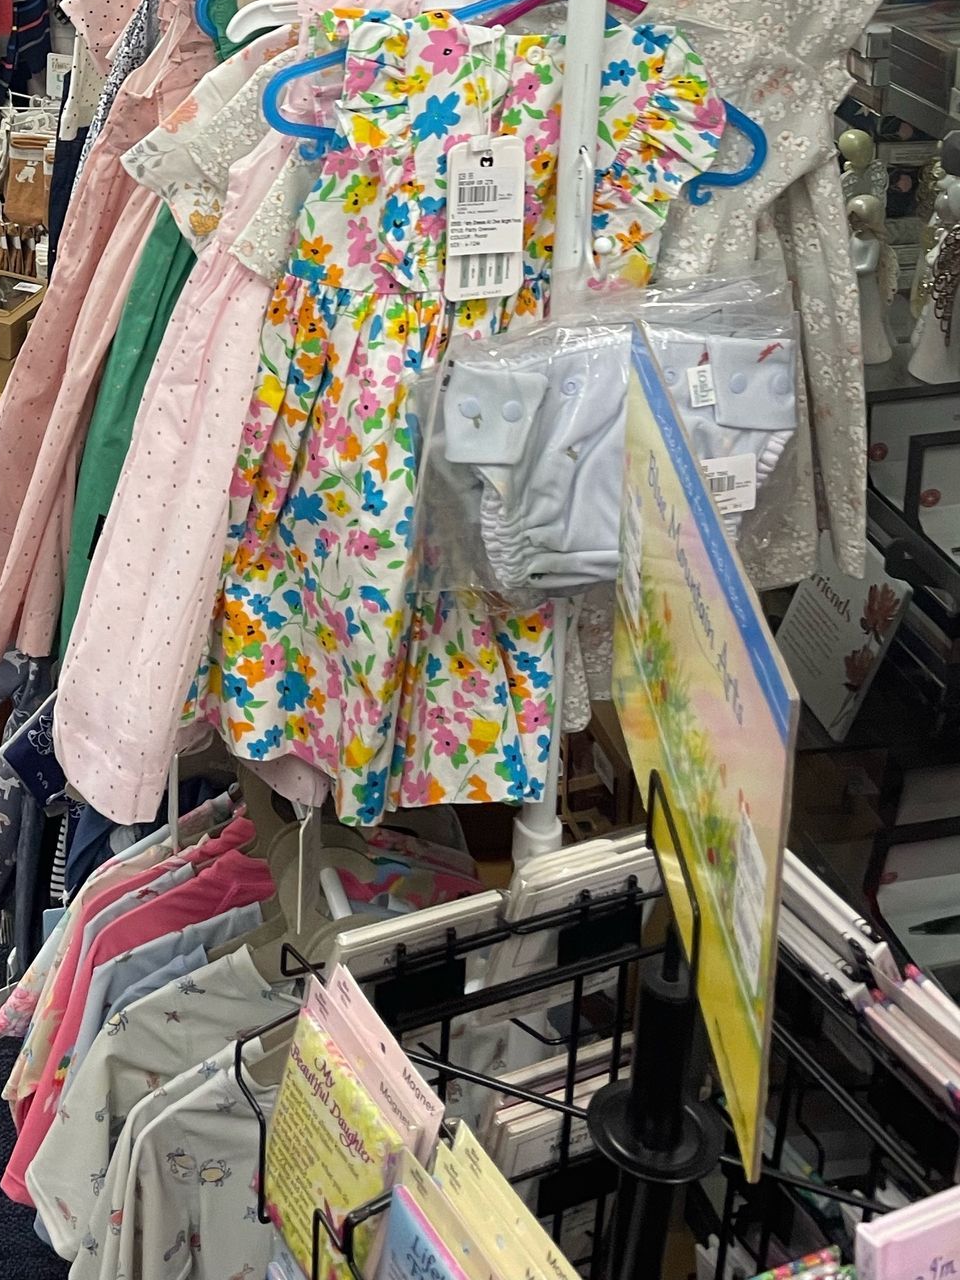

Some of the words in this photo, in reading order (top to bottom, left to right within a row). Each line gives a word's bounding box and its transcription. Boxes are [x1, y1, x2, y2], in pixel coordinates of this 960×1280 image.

[811, 574, 851, 622] riends
[313, 1057, 336, 1089] My
[403, 1066, 436, 1117] Magnet
[290, 1042, 330, 1107] Beautiful
[329, 1099, 375, 1166] Daughter
